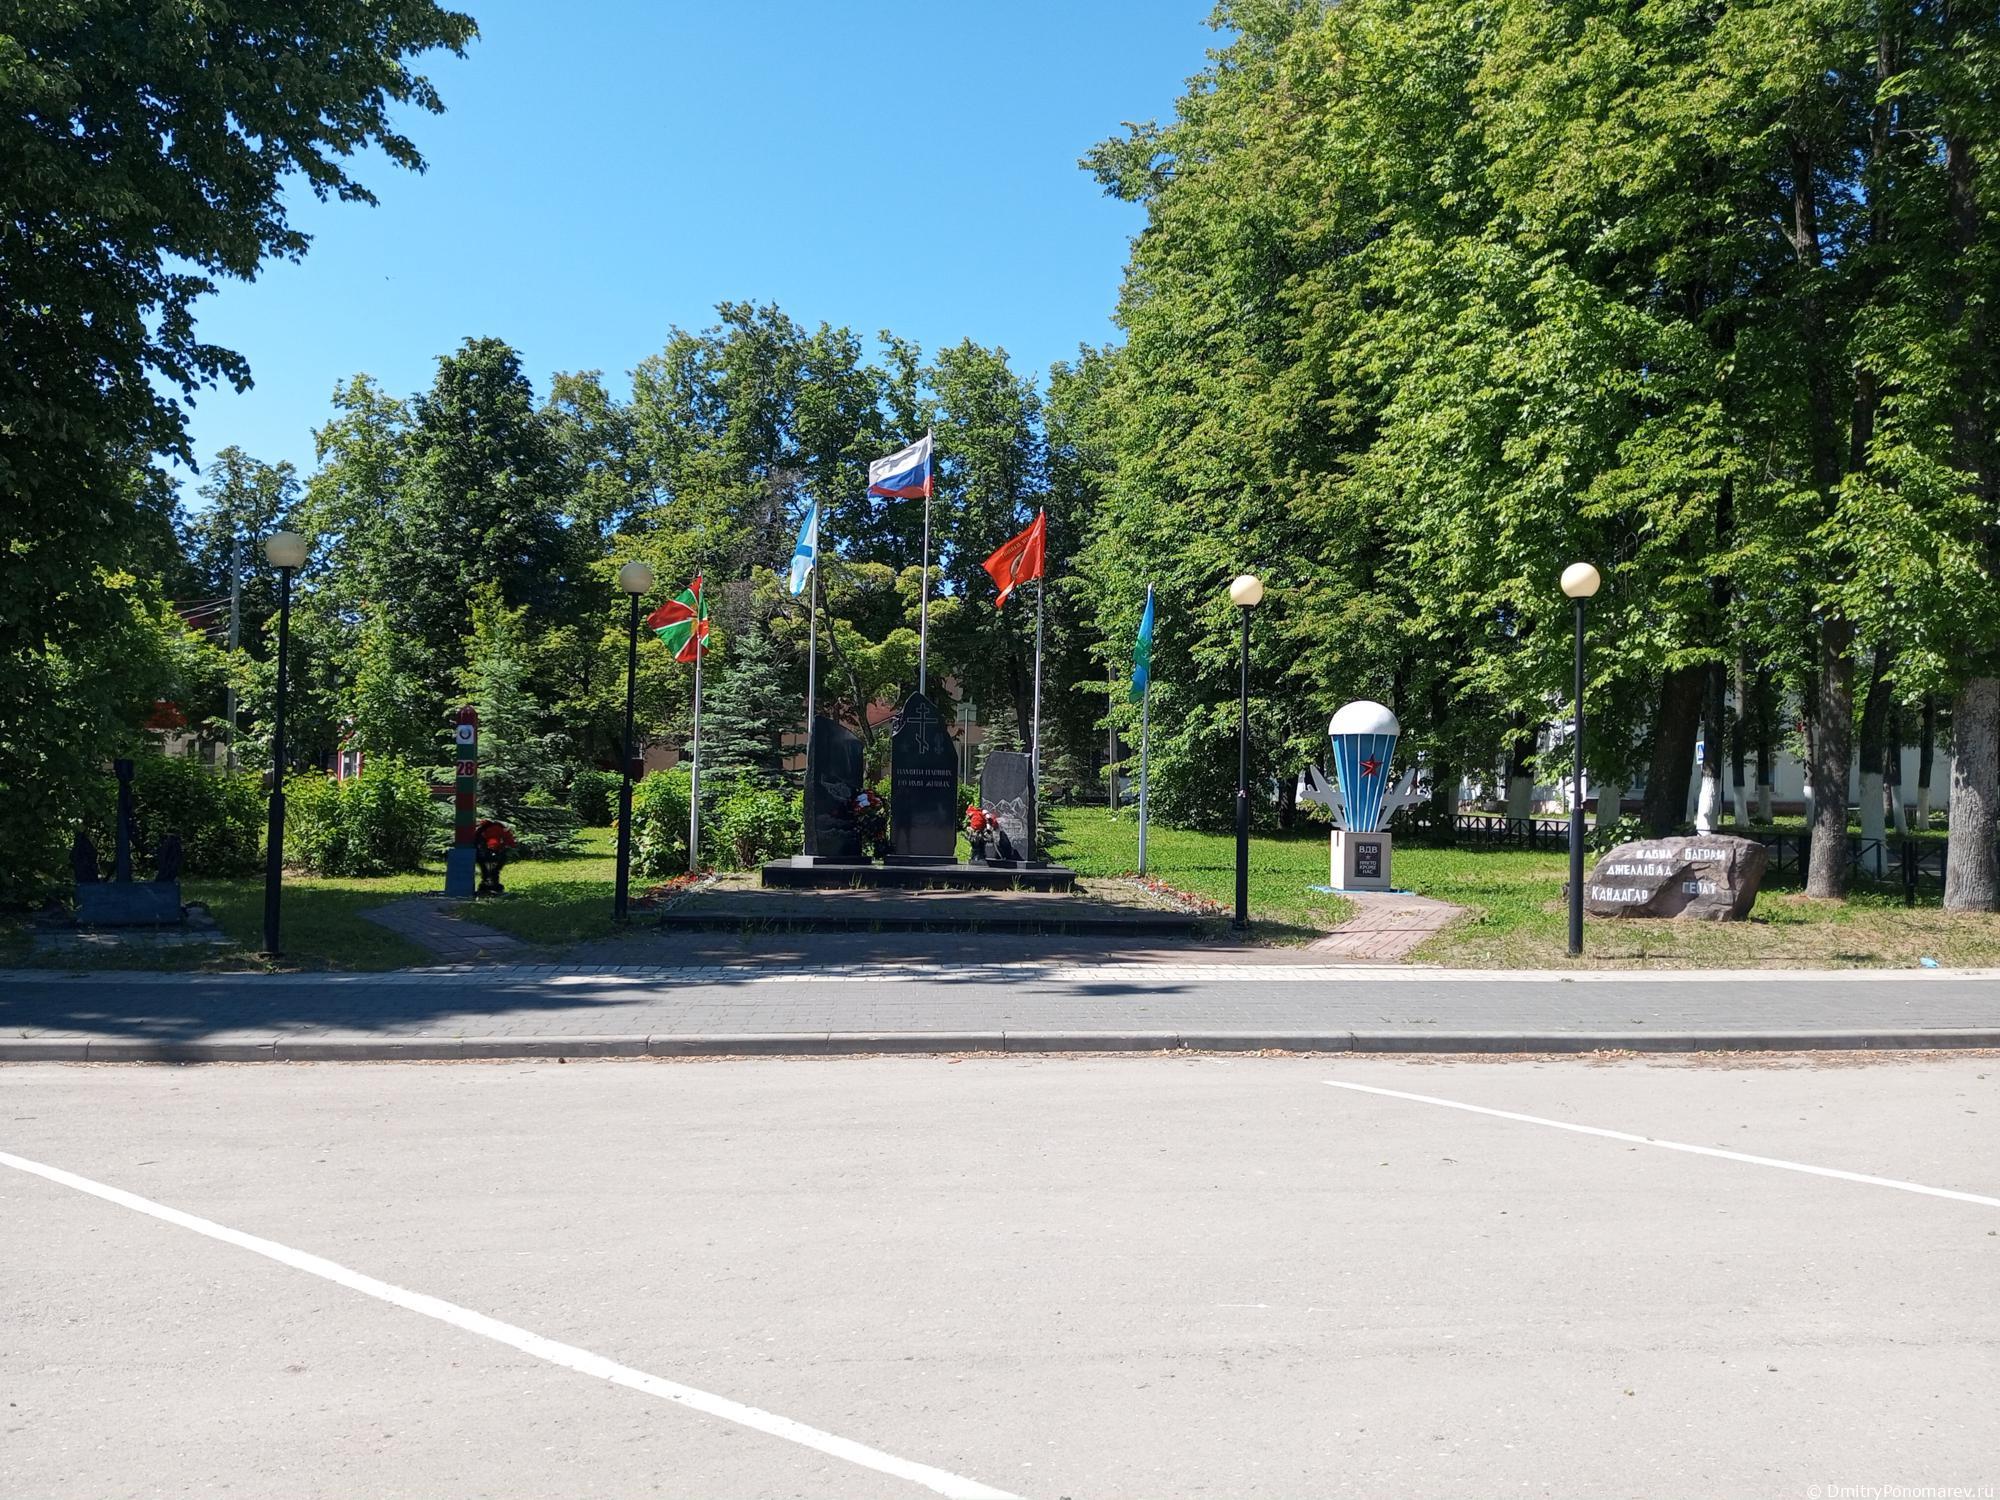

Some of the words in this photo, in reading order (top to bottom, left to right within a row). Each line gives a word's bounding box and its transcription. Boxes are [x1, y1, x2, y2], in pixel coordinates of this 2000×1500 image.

[457, 761, 474, 776] 28
[1359, 845, 1378, 853] ВДВ
[1636, 849, 1673, 860] КАБУЛ
[1684, 848, 1726, 860] БАГРАМ
[1591, 885, 1649, 902] КАНДАГАР
